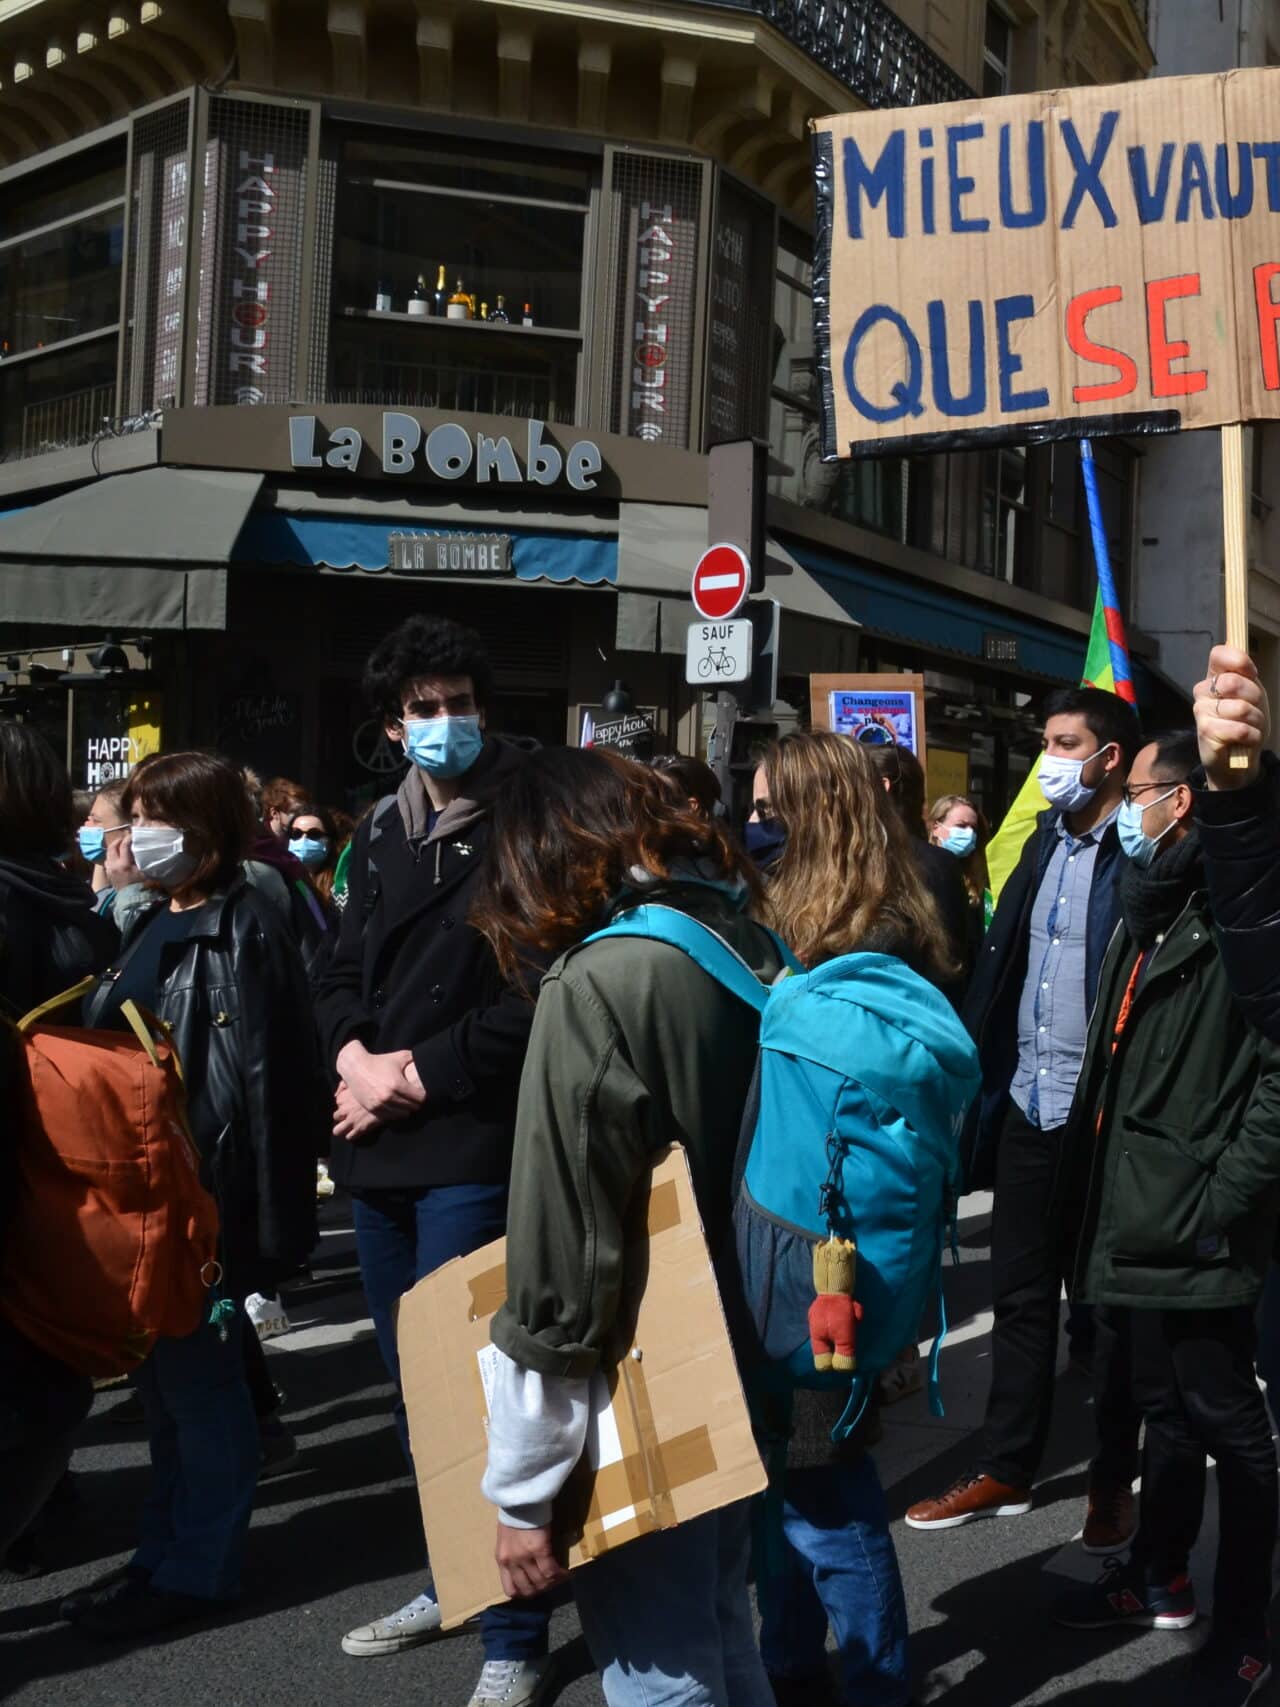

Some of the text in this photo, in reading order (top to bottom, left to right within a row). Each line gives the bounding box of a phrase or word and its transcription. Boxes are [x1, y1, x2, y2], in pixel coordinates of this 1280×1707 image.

[235, 151, 279, 268] HAPPY
[638, 201, 674, 313] HAPPY
[843, 293, 1050, 424] QUE
[1065, 273, 1209, 404] SE
[288, 415, 362, 473] La
[401, 543, 501, 570] LA BOMBE
[702, 624, 734, 641] SAUF
[88, 737, 139, 760] HAPPY
